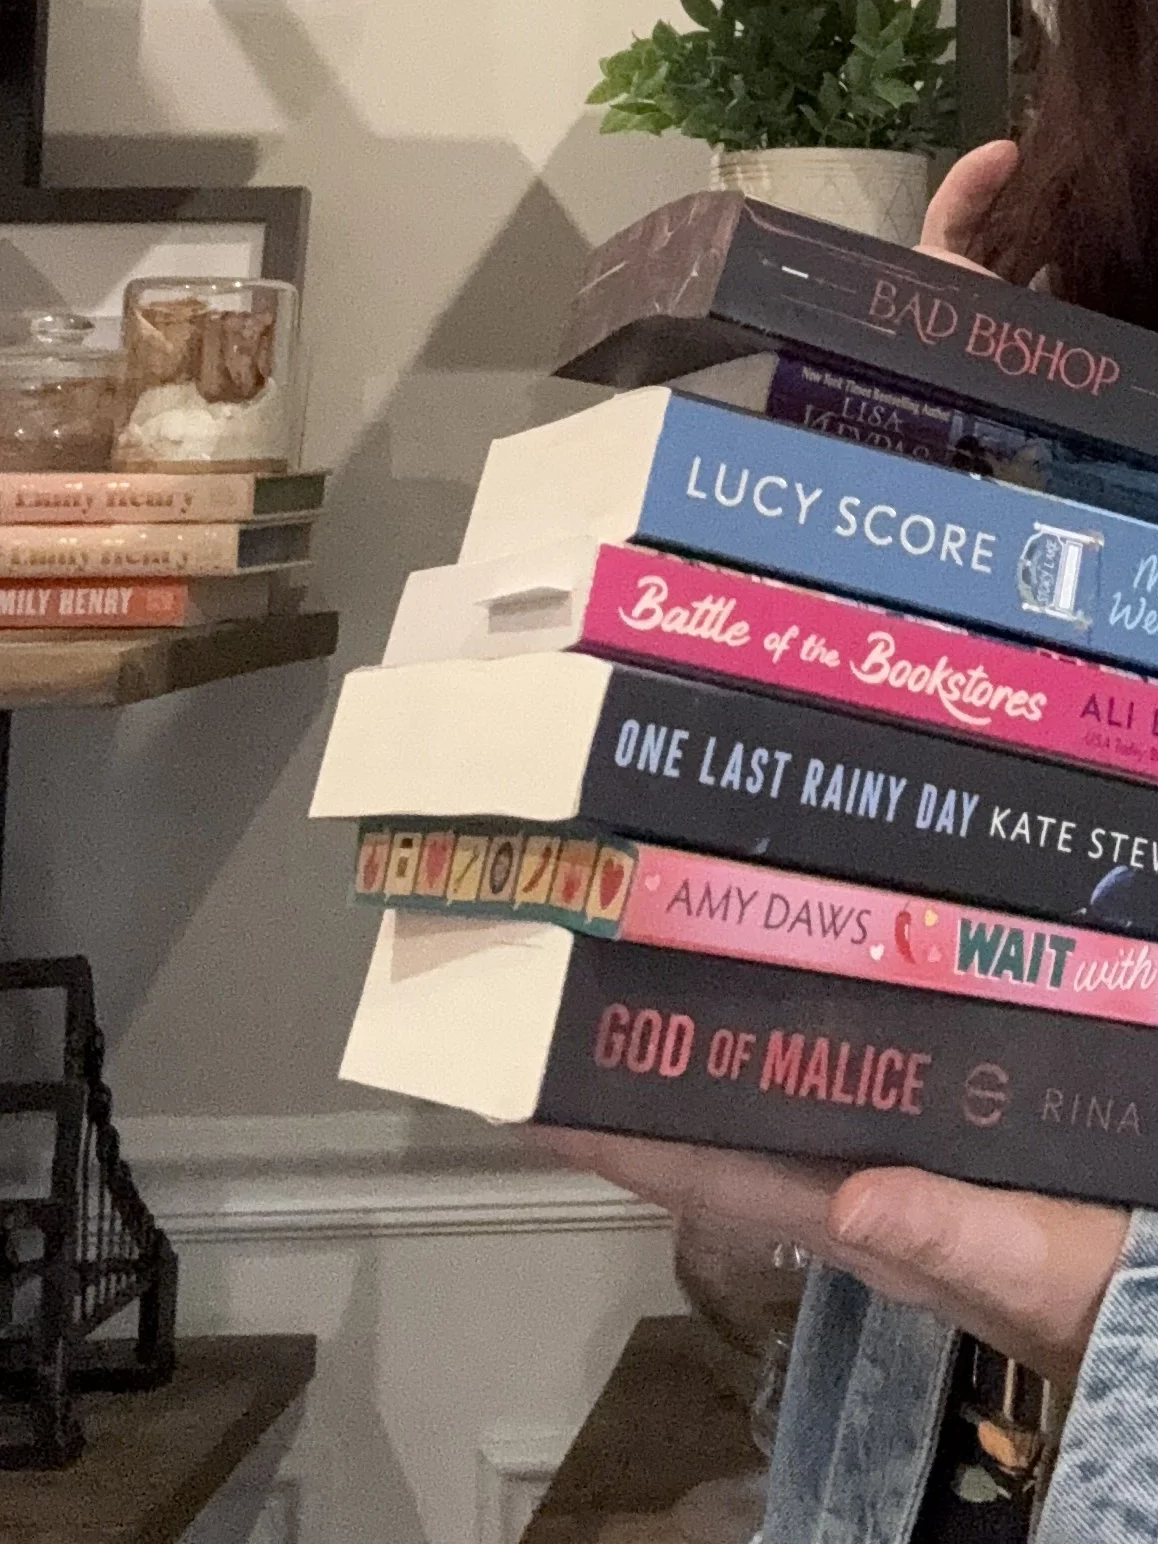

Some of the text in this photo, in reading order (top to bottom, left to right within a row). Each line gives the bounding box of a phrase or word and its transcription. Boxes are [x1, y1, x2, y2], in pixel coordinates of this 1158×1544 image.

[867, 280, 1120, 396] BAD BISHOP
[842, 397, 904, 433] LISA
[686, 456, 997, 574] LUCY SCORE
[58, 587, 134, 615] HENRY
[618, 575, 1048, 726] Battle of the Bookstores
[1079, 693, 1136, 730] ALI
[614, 718, 980, 838] ONE LAST RAINY DAY
[989, 806, 1077, 854] KATE
[665, 879, 872, 945] AMY DAWS
[953, 917, 1077, 990] WAIT
[1073, 944, 1158, 994] with
[594, 1002, 932, 1117] GOD OF MALICE
[1041, 1088, 1142, 1137] RINA
